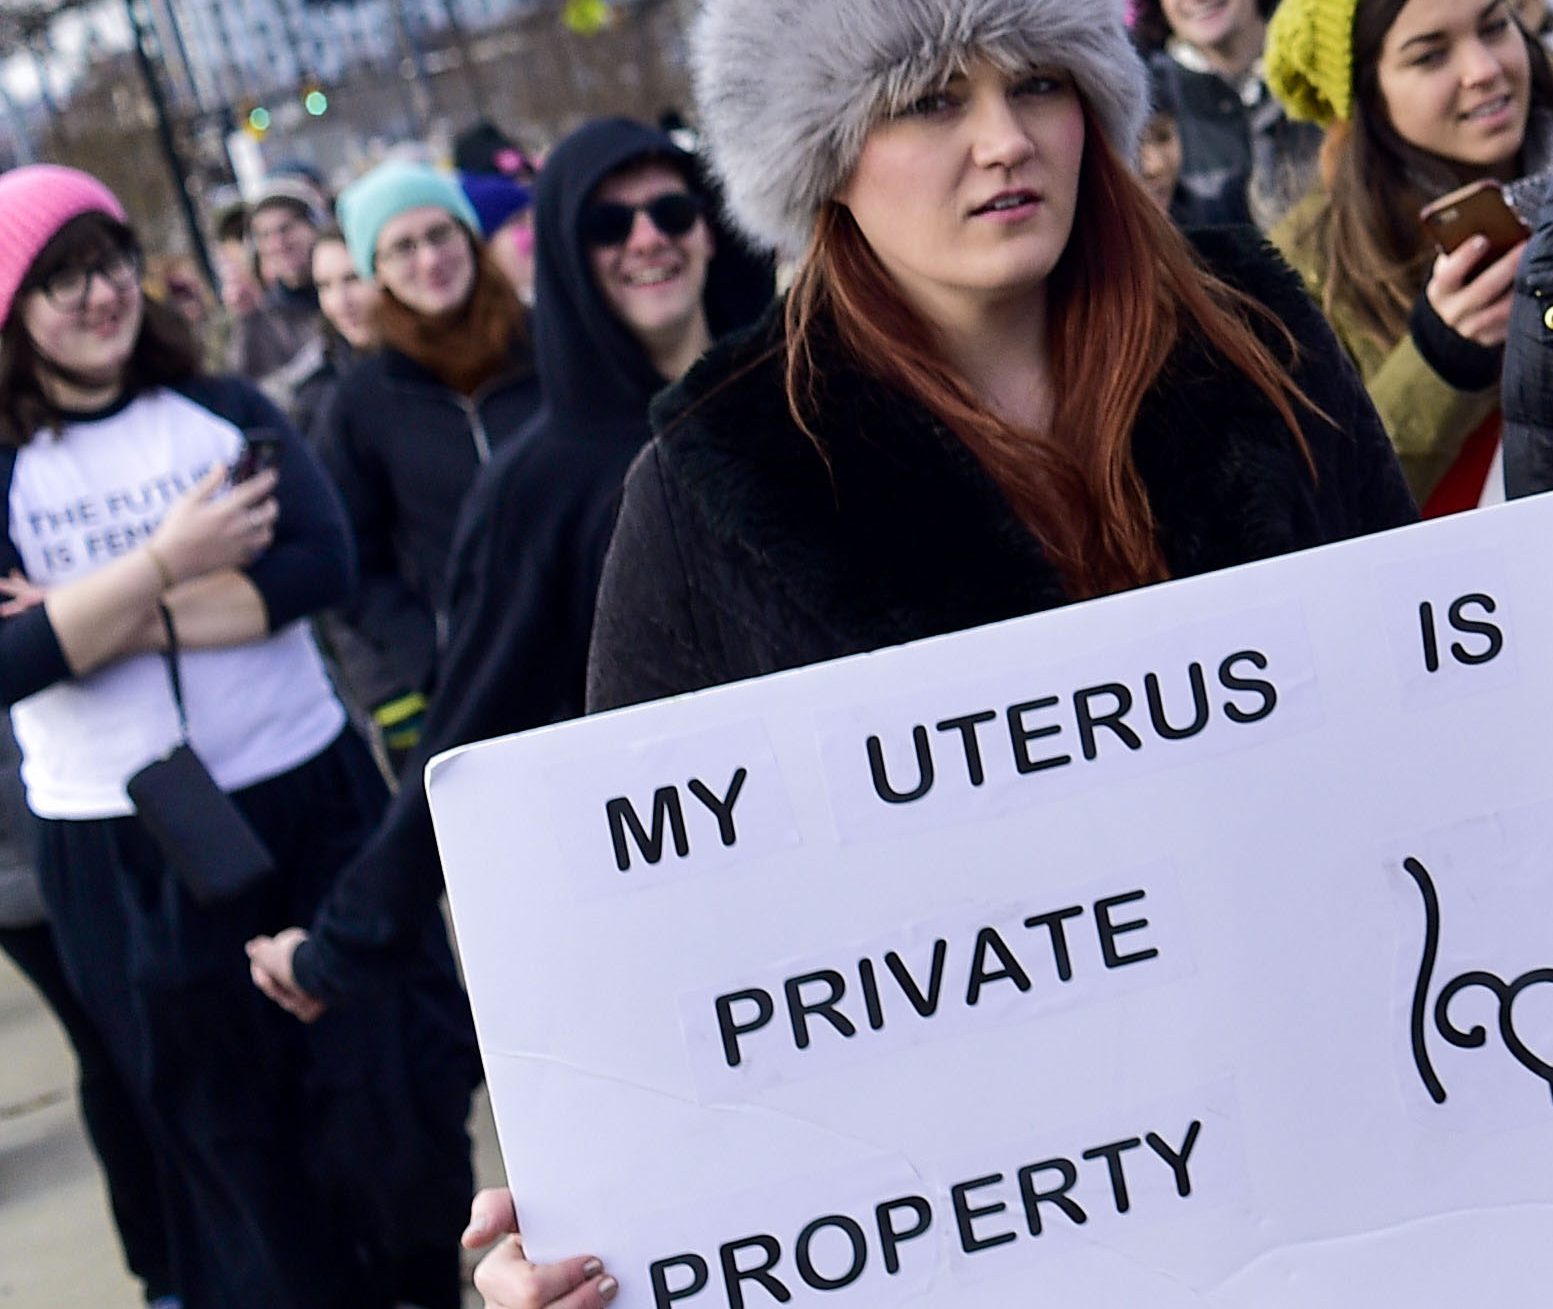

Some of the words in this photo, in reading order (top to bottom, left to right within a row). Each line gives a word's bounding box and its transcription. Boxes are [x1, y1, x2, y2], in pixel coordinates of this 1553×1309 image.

[28, 498, 97, 536] THE
[106, 465, 212, 516] FUTU
[42, 541, 76, 573] IS
[604, 765, 749, 872] MY
[864, 649, 1279, 806] UTERUS
[1418, 590, 1505, 673] IS
[713, 888, 1160, 1069] PRIVATE
[647, 1119, 1204, 1309] PROPERTY
